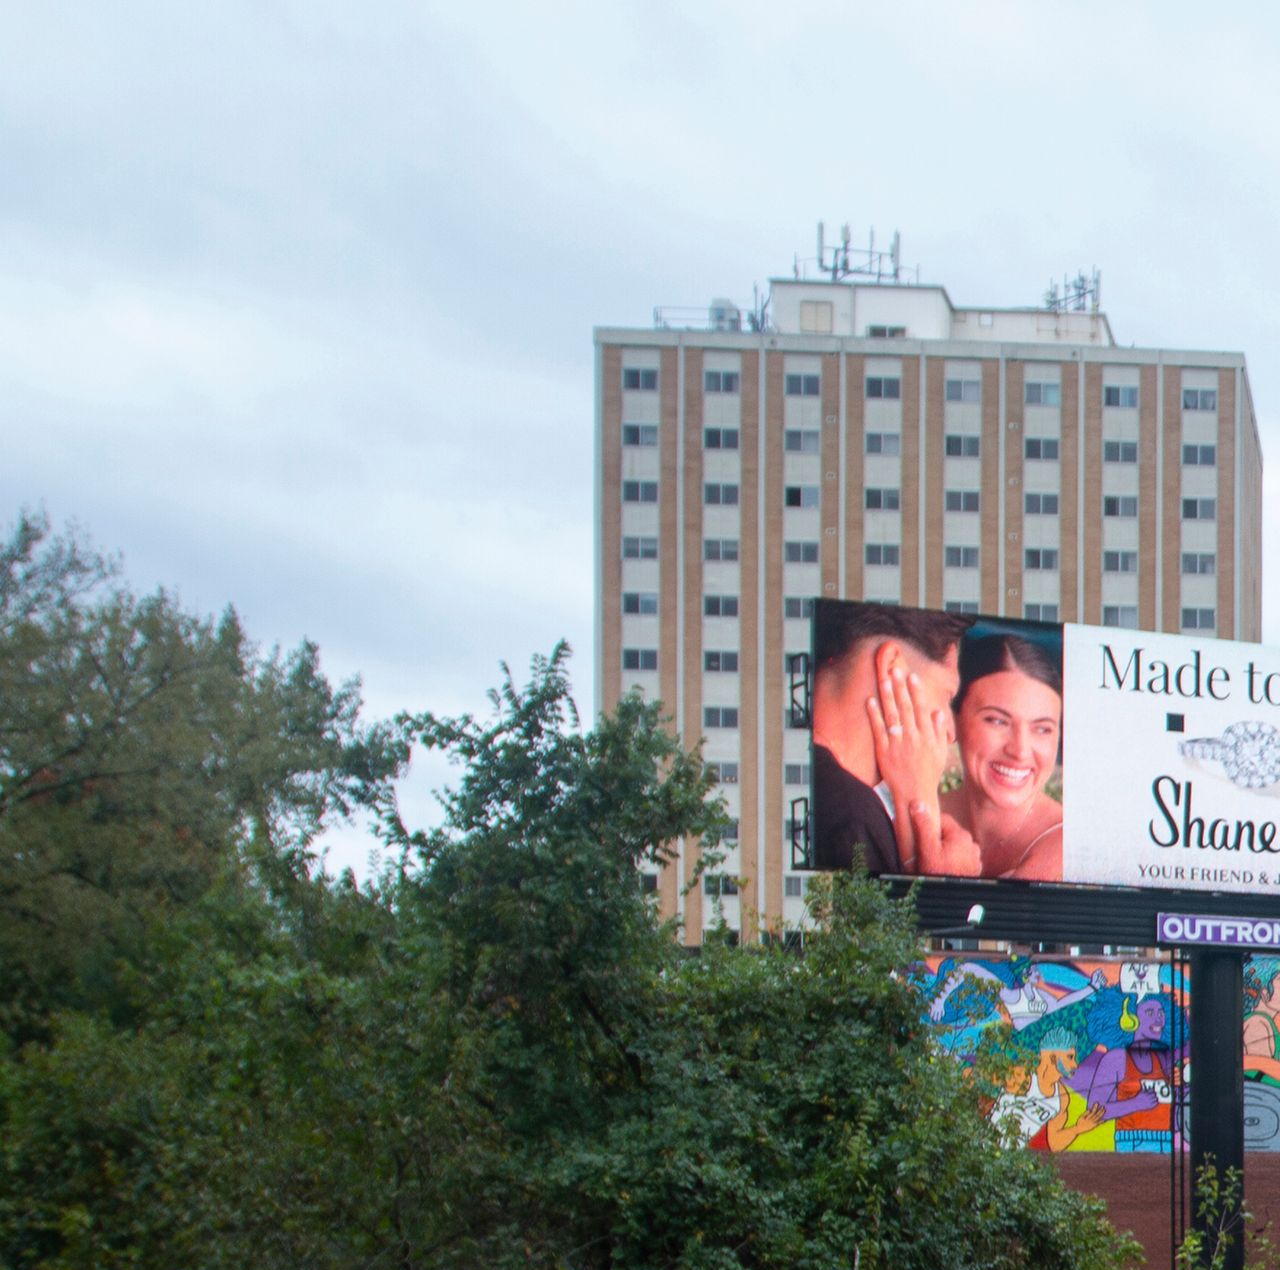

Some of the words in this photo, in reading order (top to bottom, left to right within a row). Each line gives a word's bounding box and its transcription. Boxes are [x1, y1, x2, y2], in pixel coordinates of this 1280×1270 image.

[1099, 643, 1231, 700] Made
[1138, 864, 1184, 880] YOUR
[1190, 867, 1254, 884] FRIEND
[1258, 873, 1269, 885] &
[1130, 981, 1153, 991] ATL
